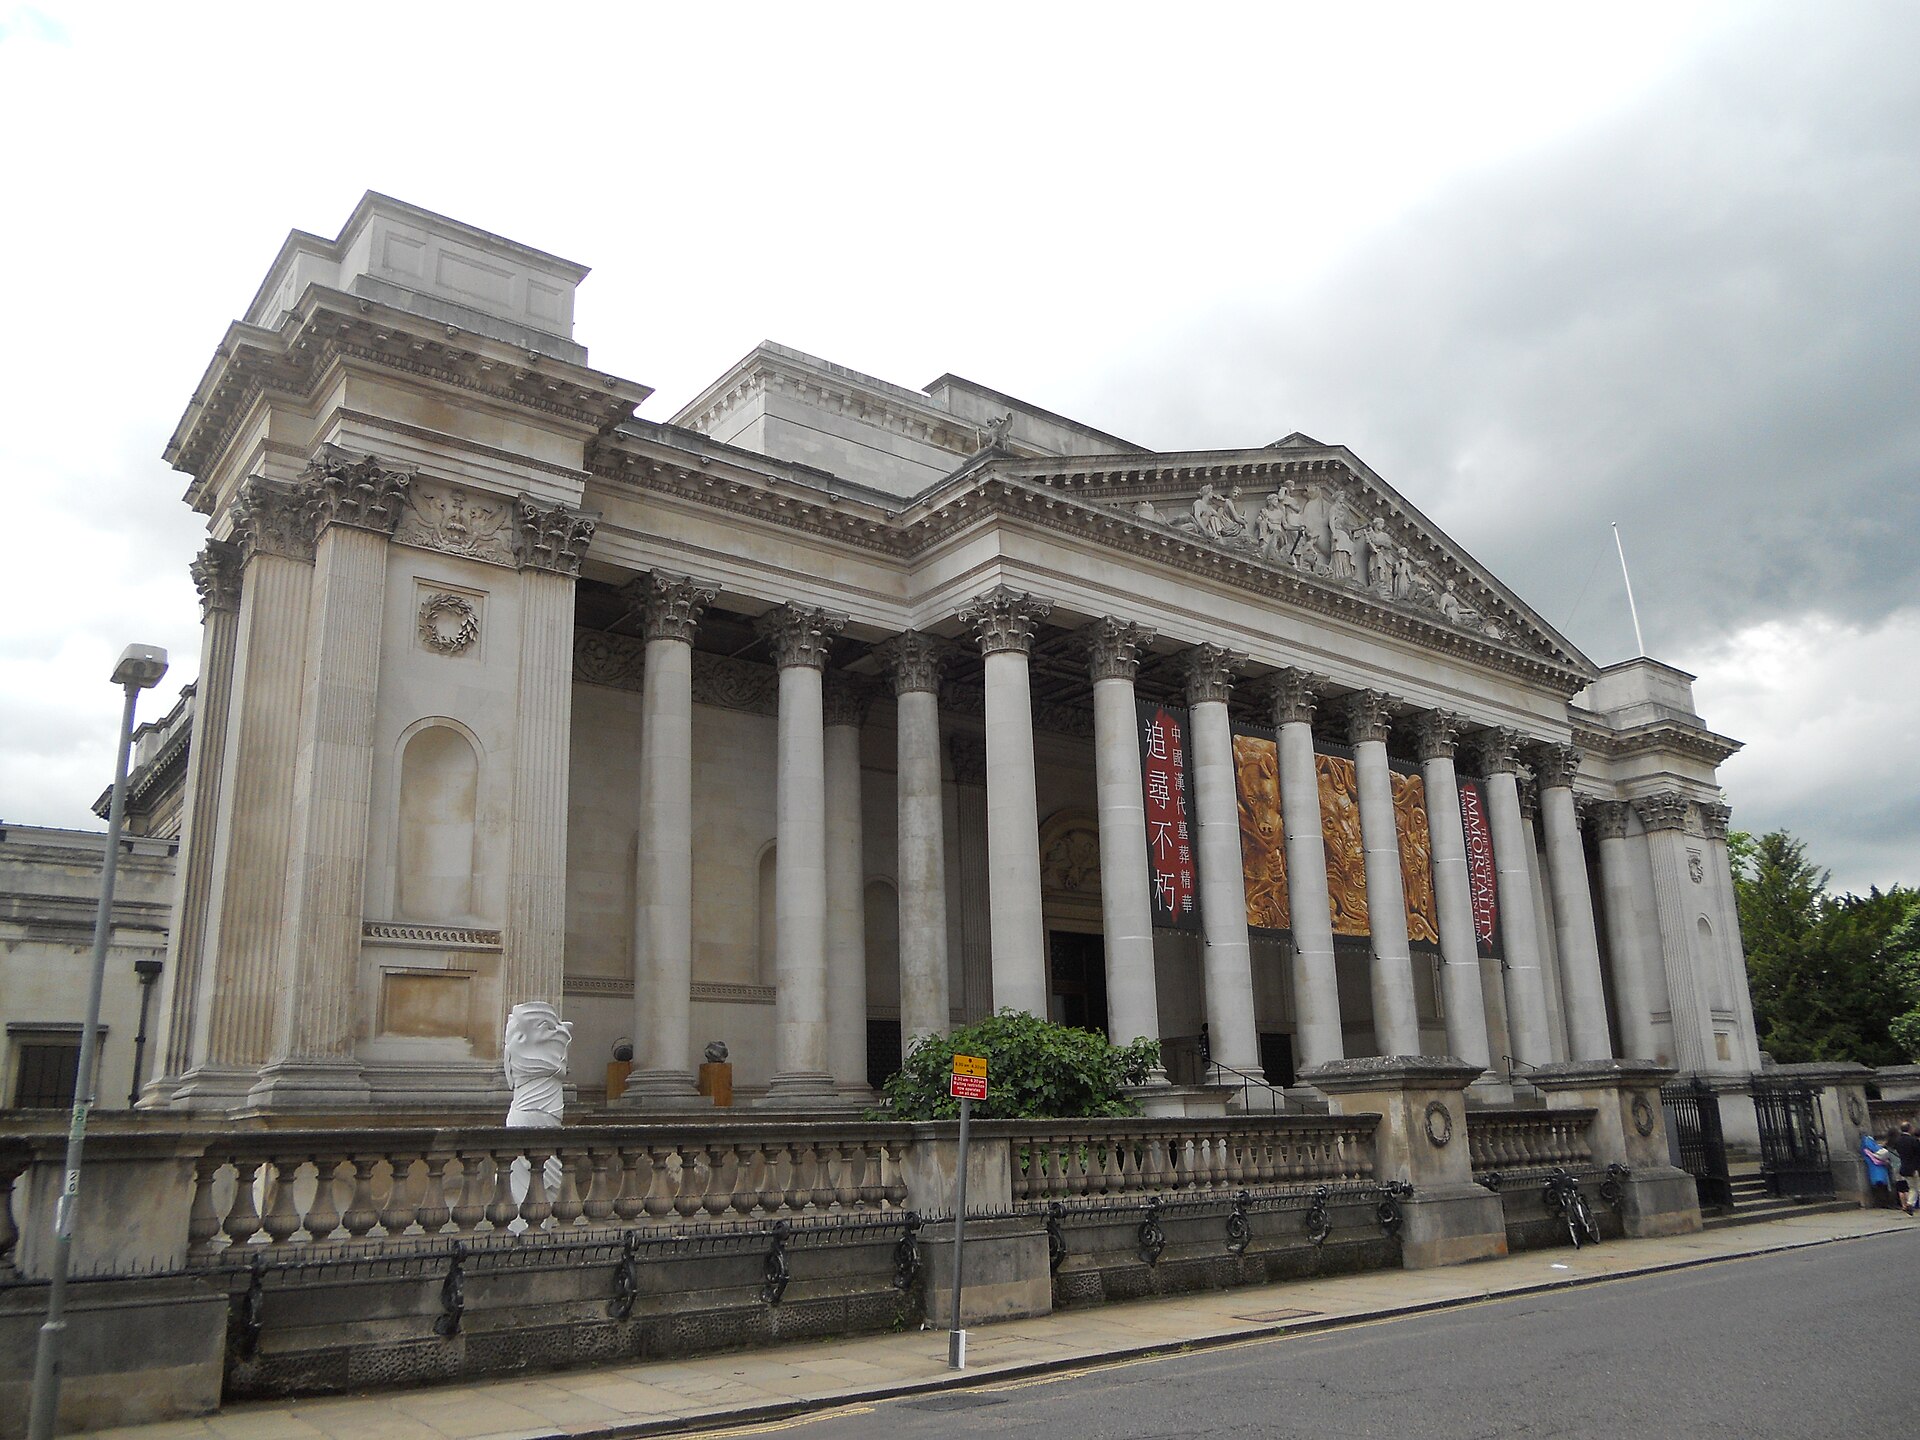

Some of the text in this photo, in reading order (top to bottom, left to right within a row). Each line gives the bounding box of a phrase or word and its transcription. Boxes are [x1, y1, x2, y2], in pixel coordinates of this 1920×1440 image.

[1145, 719, 1175, 912] 追尋不朽
[1171, 725, 1192, 913] 中國漢代墓葬精華
[1459, 788, 1482, 943] TOMB TREASURES OF HAN CHINA
[1466, 791, 1493, 945] IMMORTALITY
[1484, 848, 1493, 887] SEARCH
